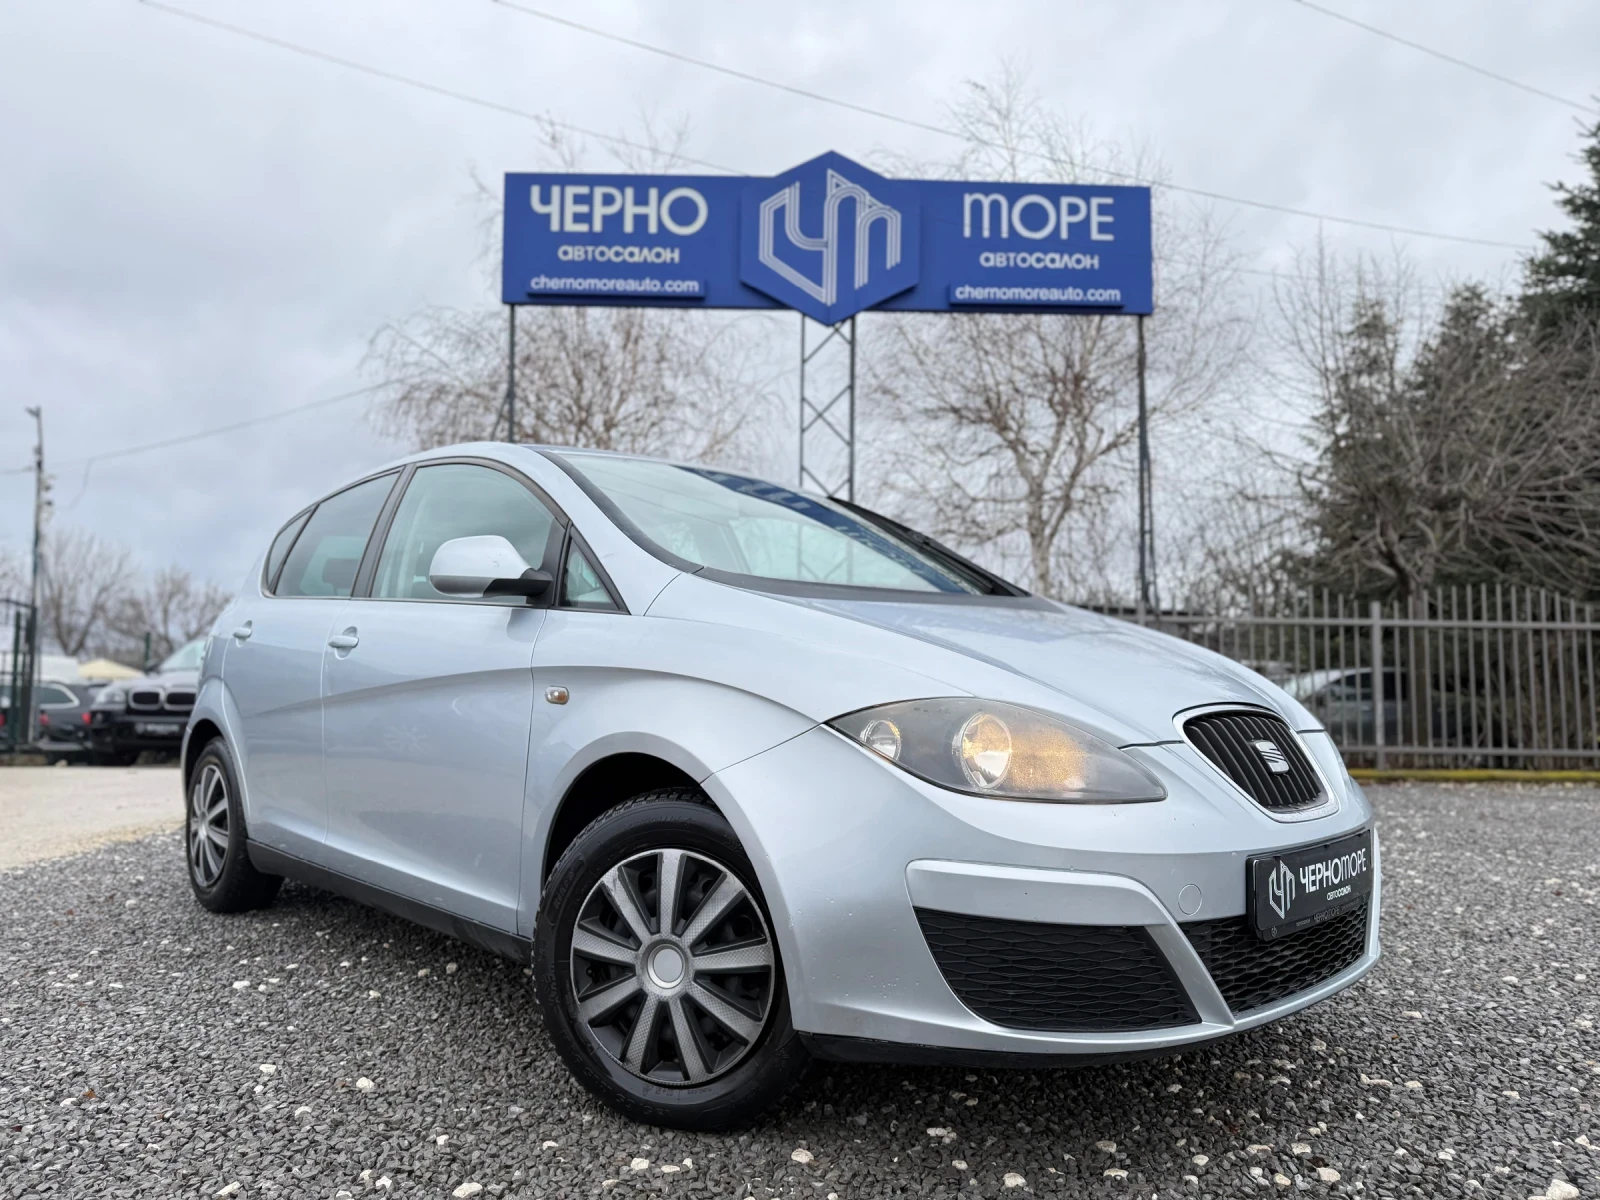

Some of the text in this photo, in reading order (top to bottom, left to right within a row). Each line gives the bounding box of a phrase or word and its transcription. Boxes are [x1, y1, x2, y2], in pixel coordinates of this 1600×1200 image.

[529, 184, 709, 236] ЧЕРНО
[963, 192, 1115, 242] МОРЕ
[557, 244, 680, 264] автосалон
[979, 251, 1100, 270] автосалон
[530, 274, 699, 293] chernomoreauto.com
[955, 284, 1121, 302] chernomoreauto.com
[1299, 848, 1367, 893] ЧЕРНОМОРЕ
